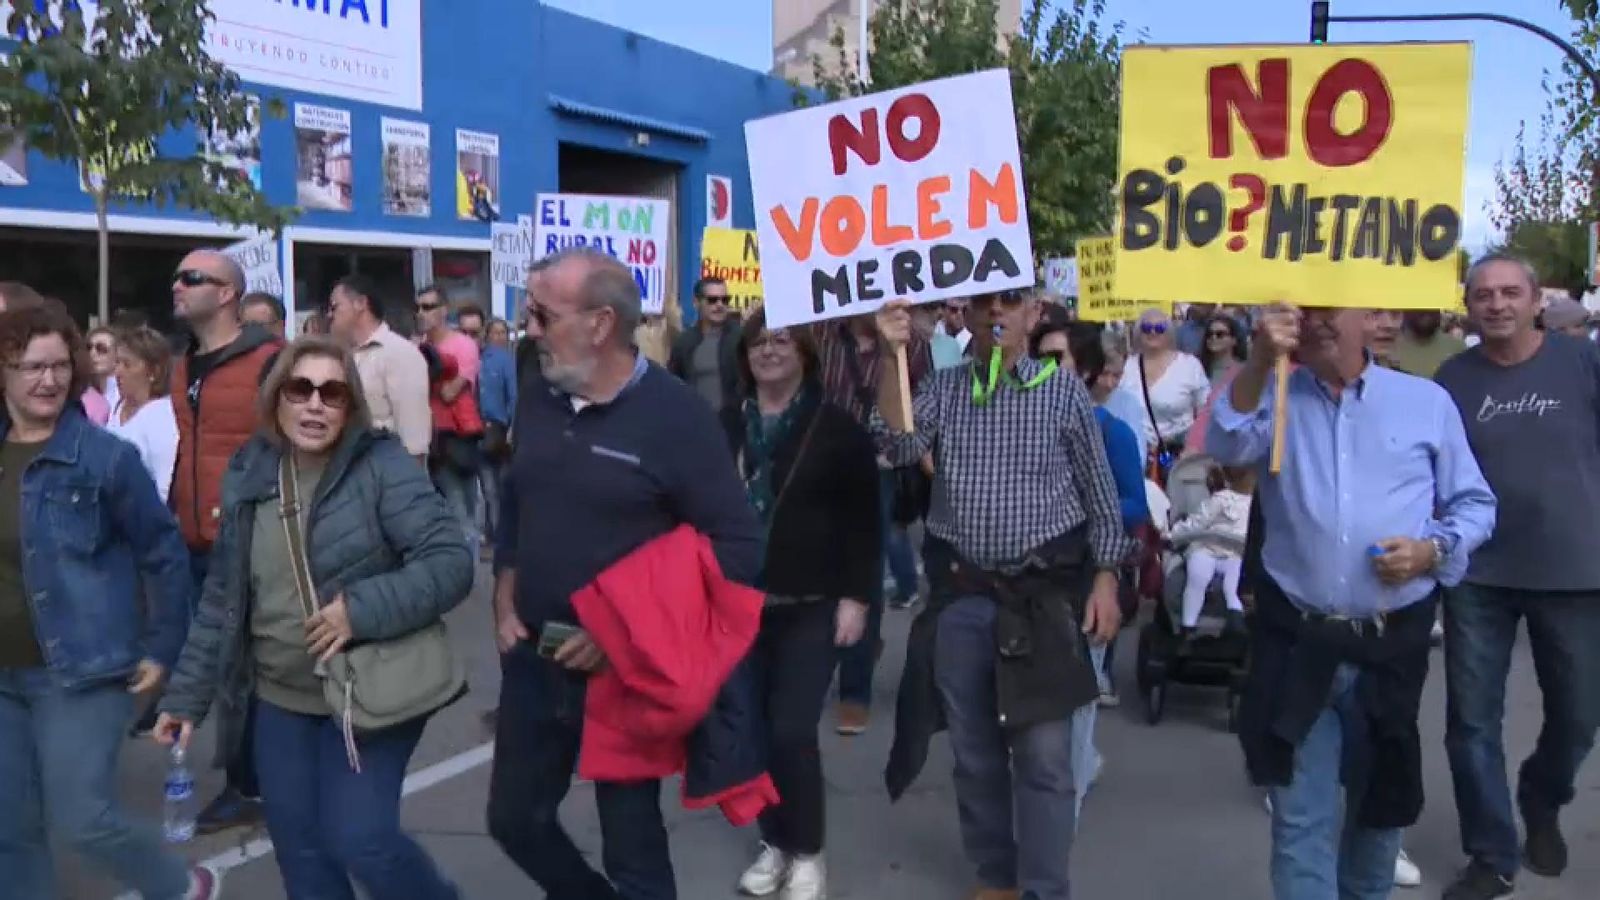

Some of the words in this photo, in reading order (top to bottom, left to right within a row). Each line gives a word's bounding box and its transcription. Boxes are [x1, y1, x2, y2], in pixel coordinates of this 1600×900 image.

[828, 92, 941, 175] NO
[1206, 57, 1395, 167] NO
[541, 199, 571, 227] EL
[769, 161, 1019, 262] VOLEM
[627, 238, 656, 265] NO
[811, 238, 1021, 314] MERDA
